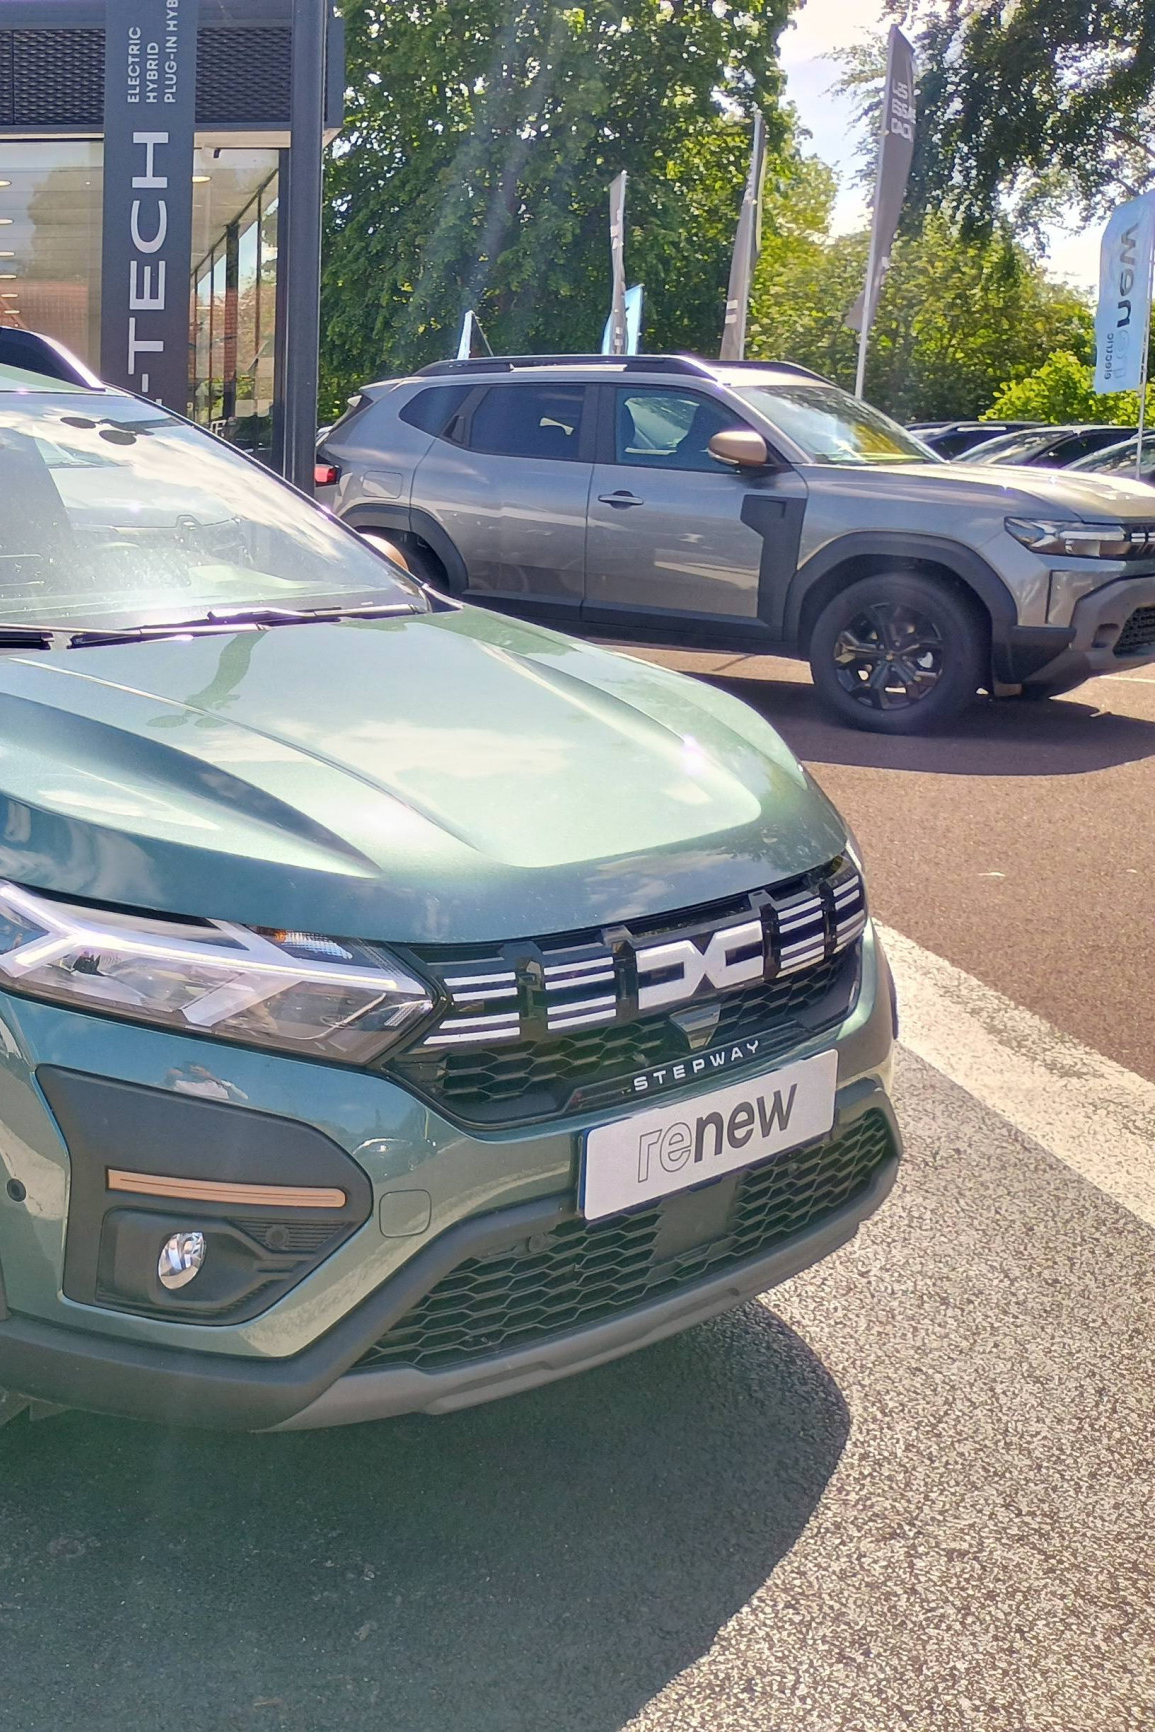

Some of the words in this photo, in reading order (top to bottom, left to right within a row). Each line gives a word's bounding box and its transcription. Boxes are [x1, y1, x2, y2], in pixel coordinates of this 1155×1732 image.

[127, 27, 141, 103] ELECTRIC
[146, 42, 159, 103] HYBRID
[163, 36, 178, 103] PLUG-IN
[128, 131, 170, 405] -TECH
[633, 1040, 760, 1093] STEPWAY
[636, 1083, 799, 1183] renew
